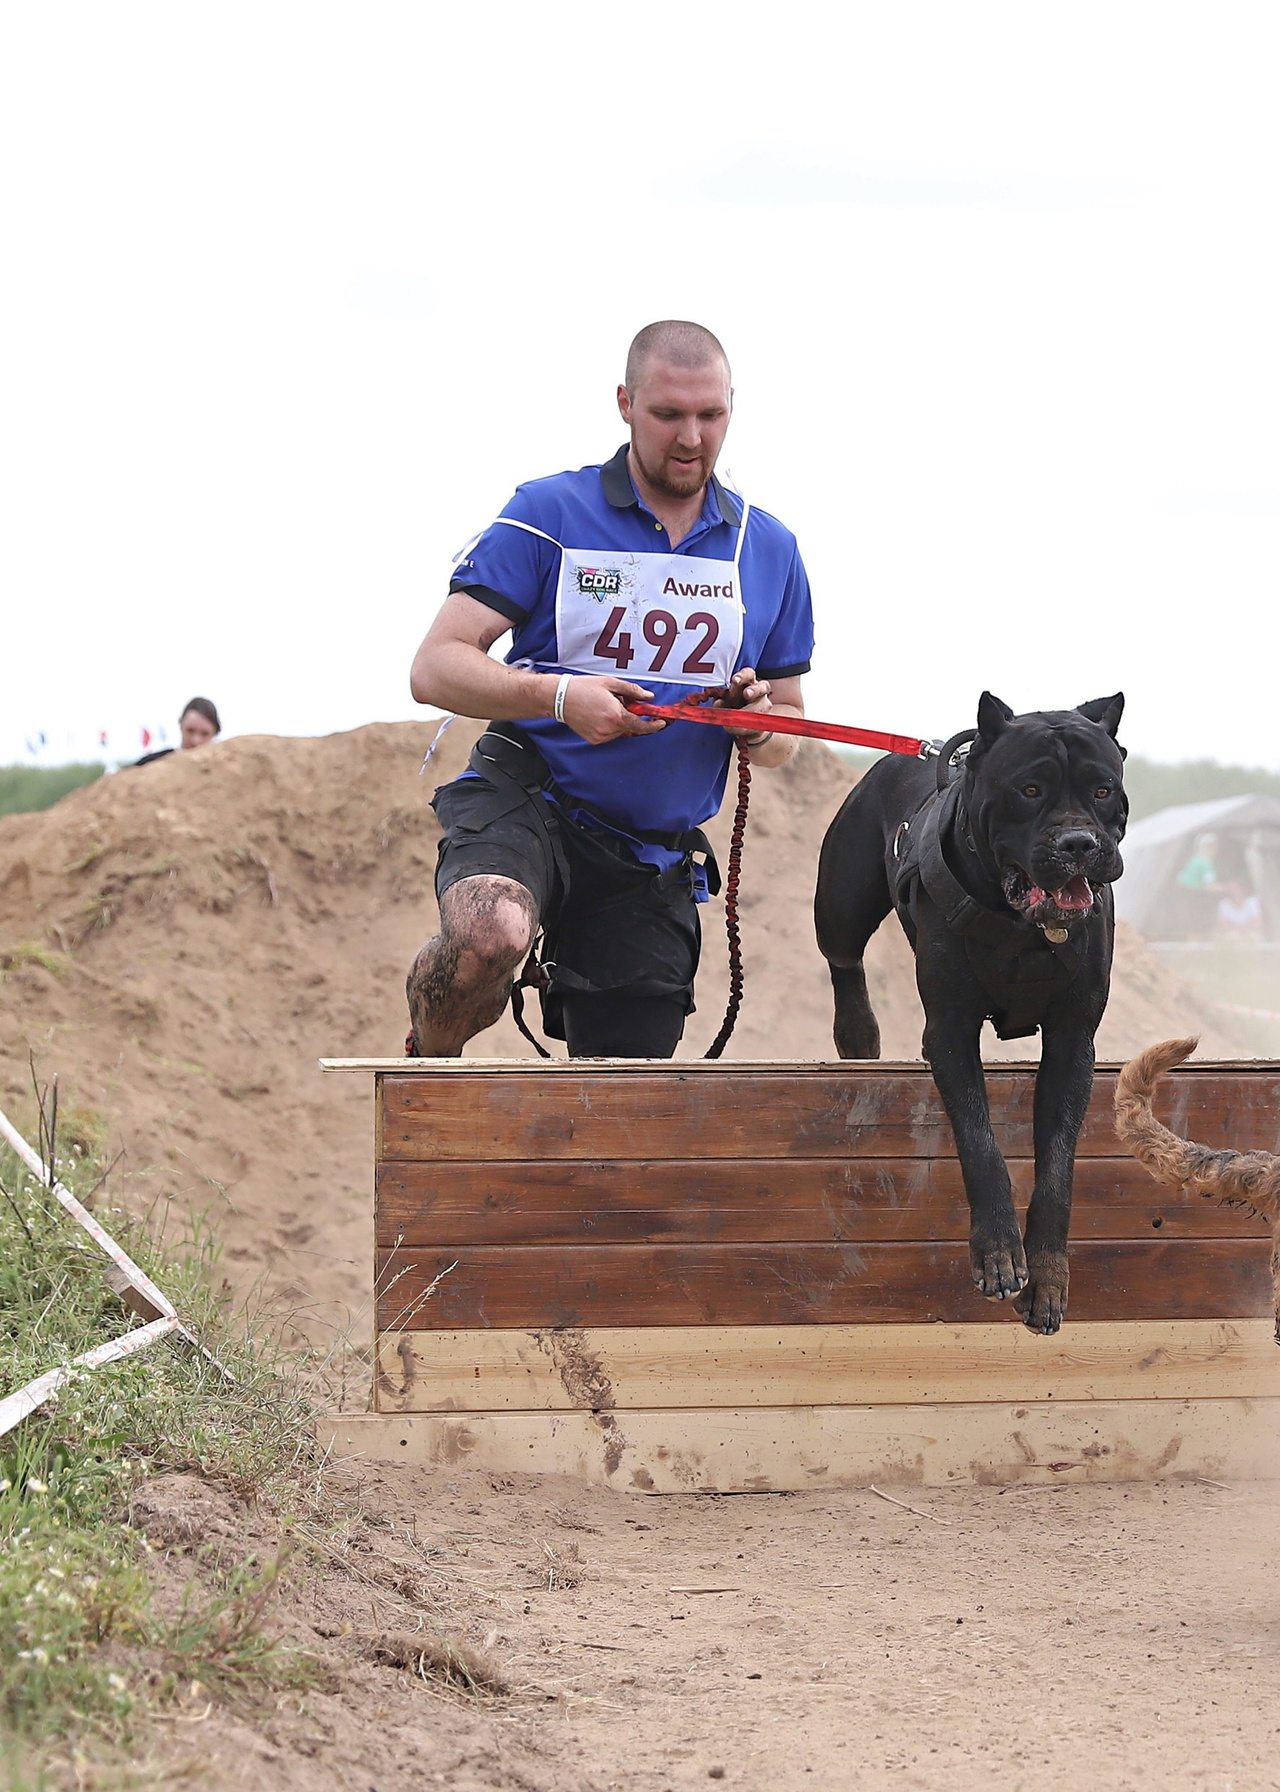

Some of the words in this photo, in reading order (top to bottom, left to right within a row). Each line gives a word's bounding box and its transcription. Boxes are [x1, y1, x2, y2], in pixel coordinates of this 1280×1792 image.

[581, 574, 618, 589] CDR
[663, 577, 734, 598] Award
[593, 606, 720, 674] 492
